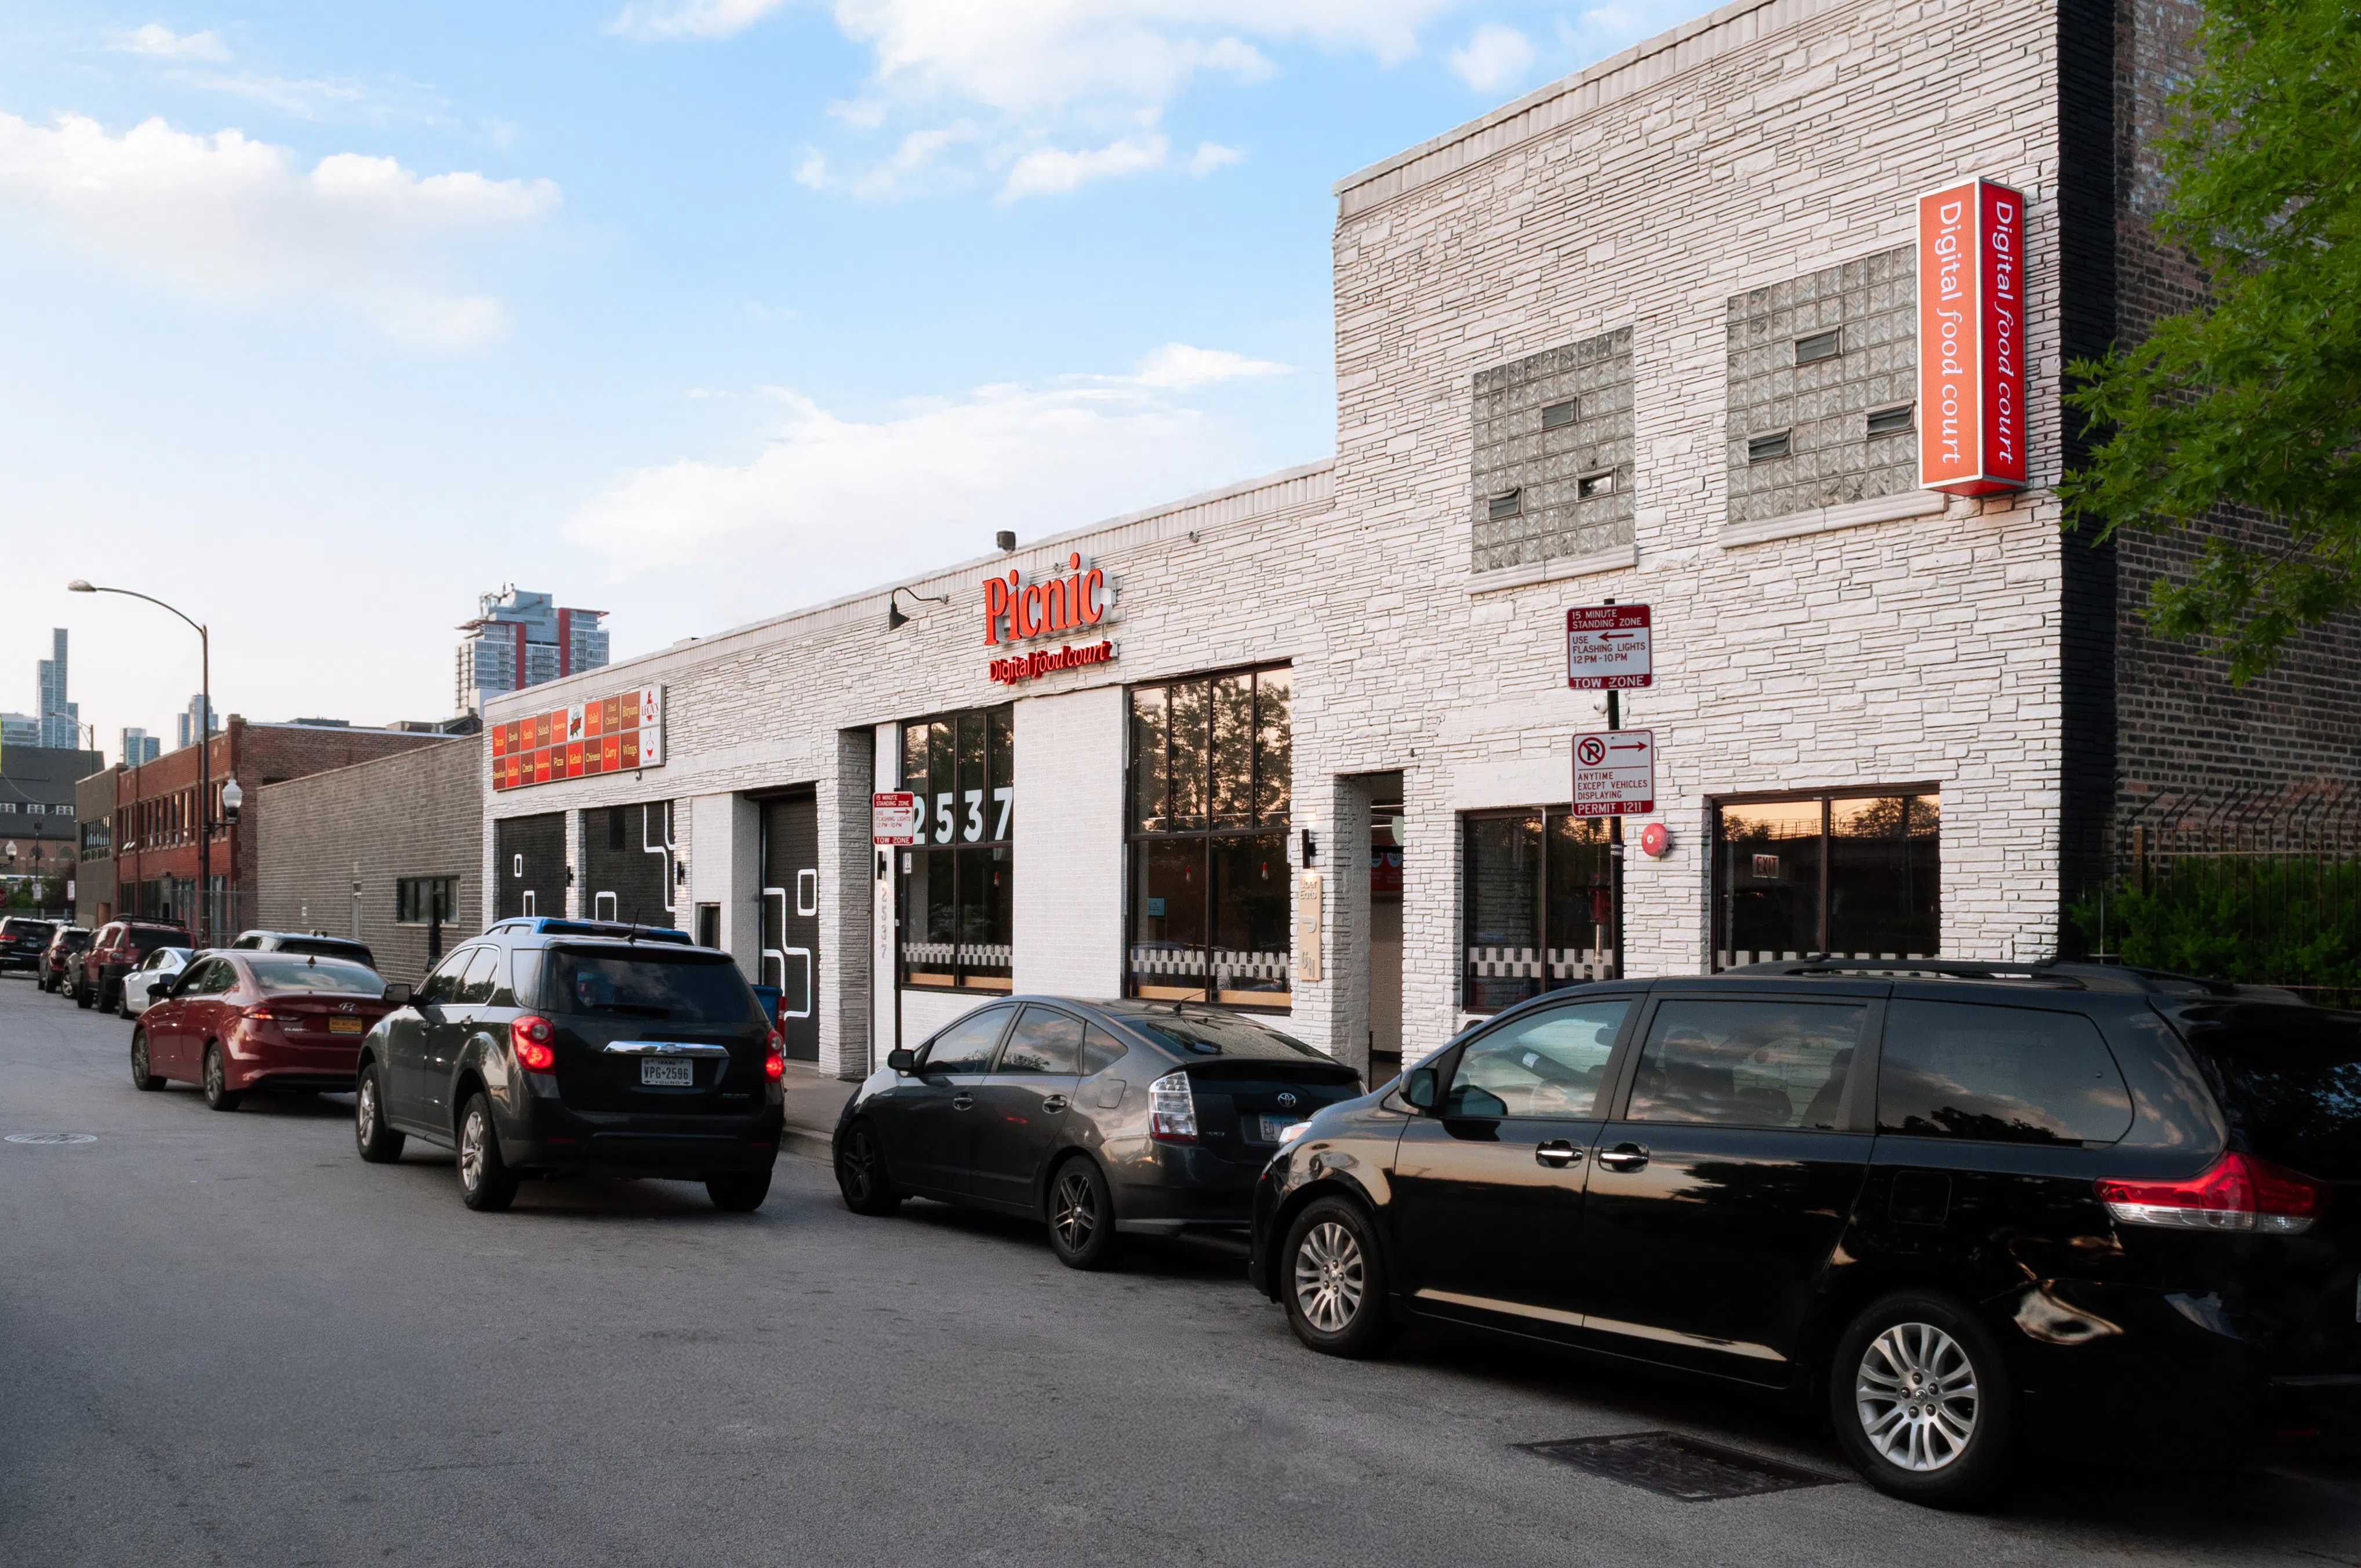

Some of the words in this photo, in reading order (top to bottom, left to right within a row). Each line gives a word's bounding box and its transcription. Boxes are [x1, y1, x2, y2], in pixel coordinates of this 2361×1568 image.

[1935, 201, 1962, 301] Digital
[1992, 201, 2014, 300] Digital
[1937, 308, 1963, 376] food
[1995, 301, 2014, 377] food
[1942, 384, 1961, 464] court
[1999, 382, 2013, 464] court
[982, 552, 1104, 645] Picnic
[1572, 611, 1581, 620] 15
[1586, 609, 1617, 618] MINUTE
[1572, 619, 1614, 630] STANDING
[1619, 617, 1642, 626] ZONE
[1572, 636, 1589, 644] USE
[1572, 644, 1612, 654] FLASHING
[1618, 642, 1646, 652] LIGHTS
[989, 652, 1030, 685] Digital
[1031, 645, 1064, 678] food
[1067, 643, 1106, 666] court
[1574, 678, 1601, 689] TOW
[1608, 676, 1644, 687] ZONE
[623, 703, 638, 718] Biryani
[605, 747, 617, 759] Curry
[623, 744, 637, 756] Wings
[554, 757, 564, 766] Pizza
[586, 753, 600, 762] Chinese
[1578, 772, 1614, 781] ANYTIME
[1578, 782, 1606, 790] EXCEPT
[1611, 780, 1648, 788] VEHICLES
[1578, 791, 1622, 800] DISPLAYING
[1578, 803, 1616, 814] PERMIT
[1623, 802, 1641, 812] 1211
[1757, 856, 1777, 874] EXIT
[1300, 879, 1317, 889] Uber
[1301, 890, 1317, 900] Eats
